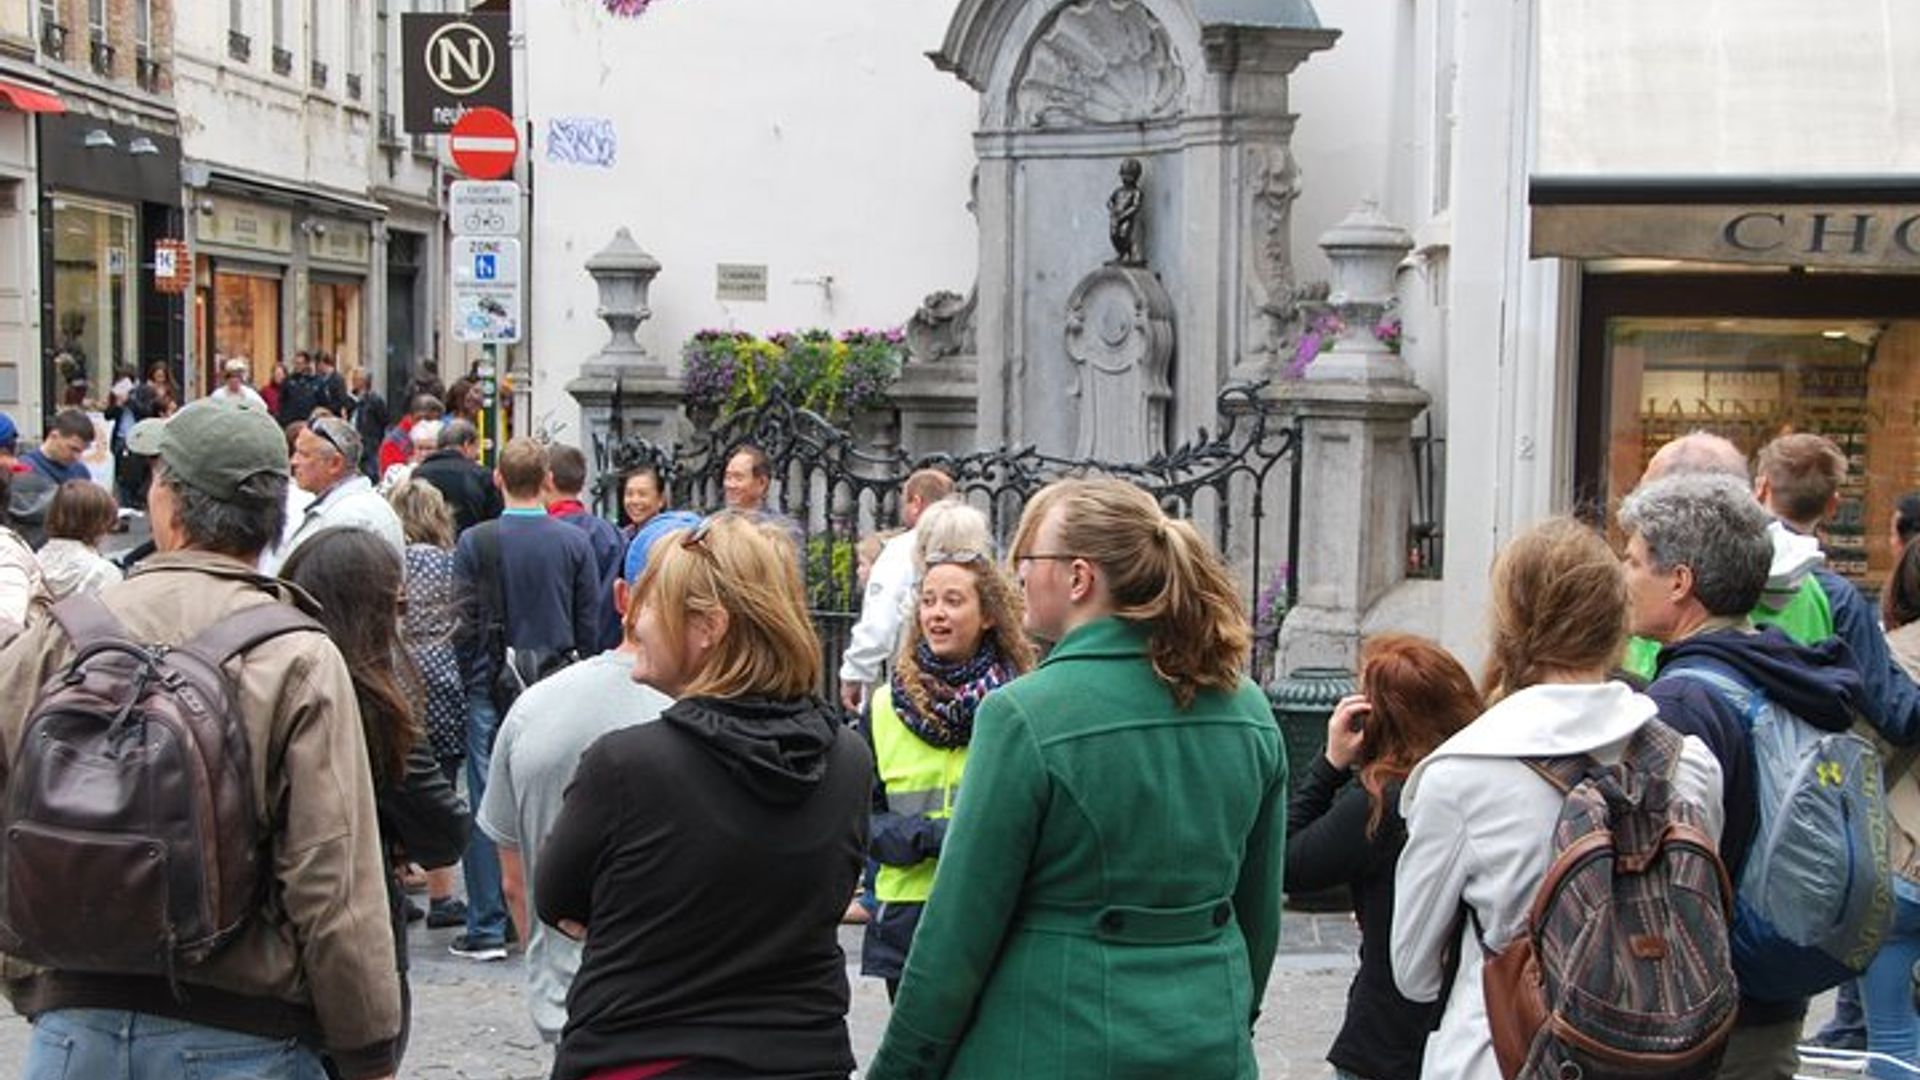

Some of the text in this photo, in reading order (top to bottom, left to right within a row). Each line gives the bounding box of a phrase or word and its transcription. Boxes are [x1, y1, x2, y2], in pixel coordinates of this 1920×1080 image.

[439, 38, 481, 80] N
[433, 101, 473, 125] neuh
[469, 240, 501, 253] ZONE
